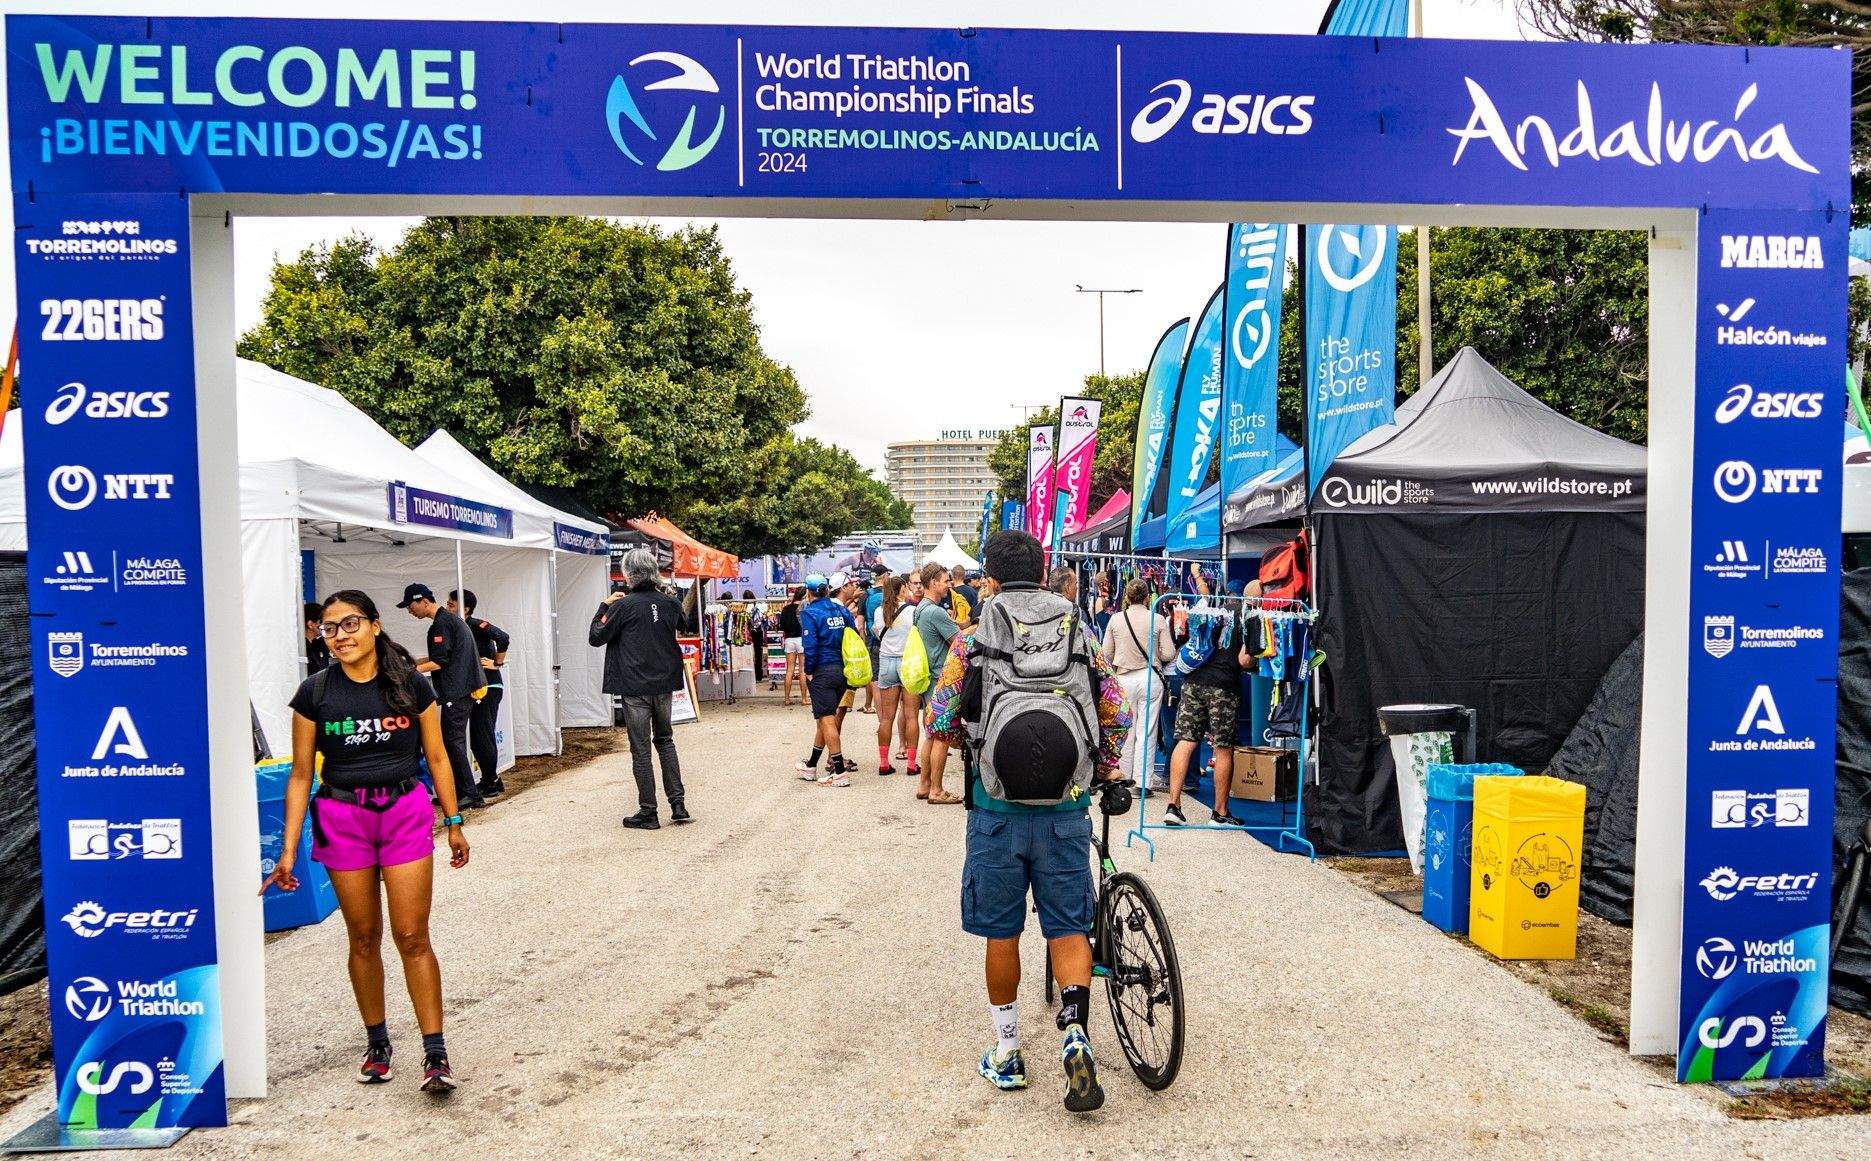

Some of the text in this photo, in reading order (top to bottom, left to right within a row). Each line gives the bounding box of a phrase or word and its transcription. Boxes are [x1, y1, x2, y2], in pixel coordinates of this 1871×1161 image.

[755, 52, 970, 82] World Triathlon
[35, 43, 478, 111] WELCOME!
[755, 85, 1034, 118] Championship Finals
[1192, 94, 1315, 135] asics
[1446, 76, 1820, 174] Andalucía
[40, 118, 483, 167] ¡BIENVENIDOS/AS!
[757, 126, 1099, 152] TORREMOLINOS-ANDALUCÍA
[758, 152, 808, 173] 2024
[26, 239, 177, 254] TORREMOLINOS
[1721, 235, 1824, 269] MARCA
[41, 299, 164, 341] 226ERS
[1717, 325, 1827, 347] Halcón viajes
[1321, 335, 1350, 359] the
[86, 391, 170, 418] asics
[1751, 392, 1824, 418] asics
[942, 430, 973, 439] HOTEL
[103, 474, 174, 499] NTT
[1404, 481, 1420, 489] the
[1472, 477, 1632, 498] www.wildstore.pt
[1762, 469, 1822, 493] NTT
[1404, 488, 1435, 498] sports
[413, 496, 449, 519] TURISMO
[450, 504, 498, 528] TORREMOLINOS
[560, 530, 583, 547] FINISHER
[1777, 547, 1823, 557] MÁLAGA
[127, 557, 181, 568] MÁLAGA
[1773, 557, 1827, 568] COMPITE
[123, 569, 187, 580] COMPITE
[1740, 626, 1823, 639] Torremolinos
[90, 643, 188, 656] Torremolinos
[1740, 640, 1796, 648] AYUNTAMIENTO
[91, 658, 156, 666] AYUNTAMIENTO
[325, 716, 410, 736] MÉXICO
[344, 731, 391, 746] SIGO YO
[1709, 737, 1815, 752] Junta de Andalucía
[61, 763, 185, 778] Junta de Andalucía
[1743, 939, 1795, 956] World
[1743, 957, 1816, 974] Triathlon
[118, 980, 177, 998] World
[119, 999, 204, 1016] Triathlon
